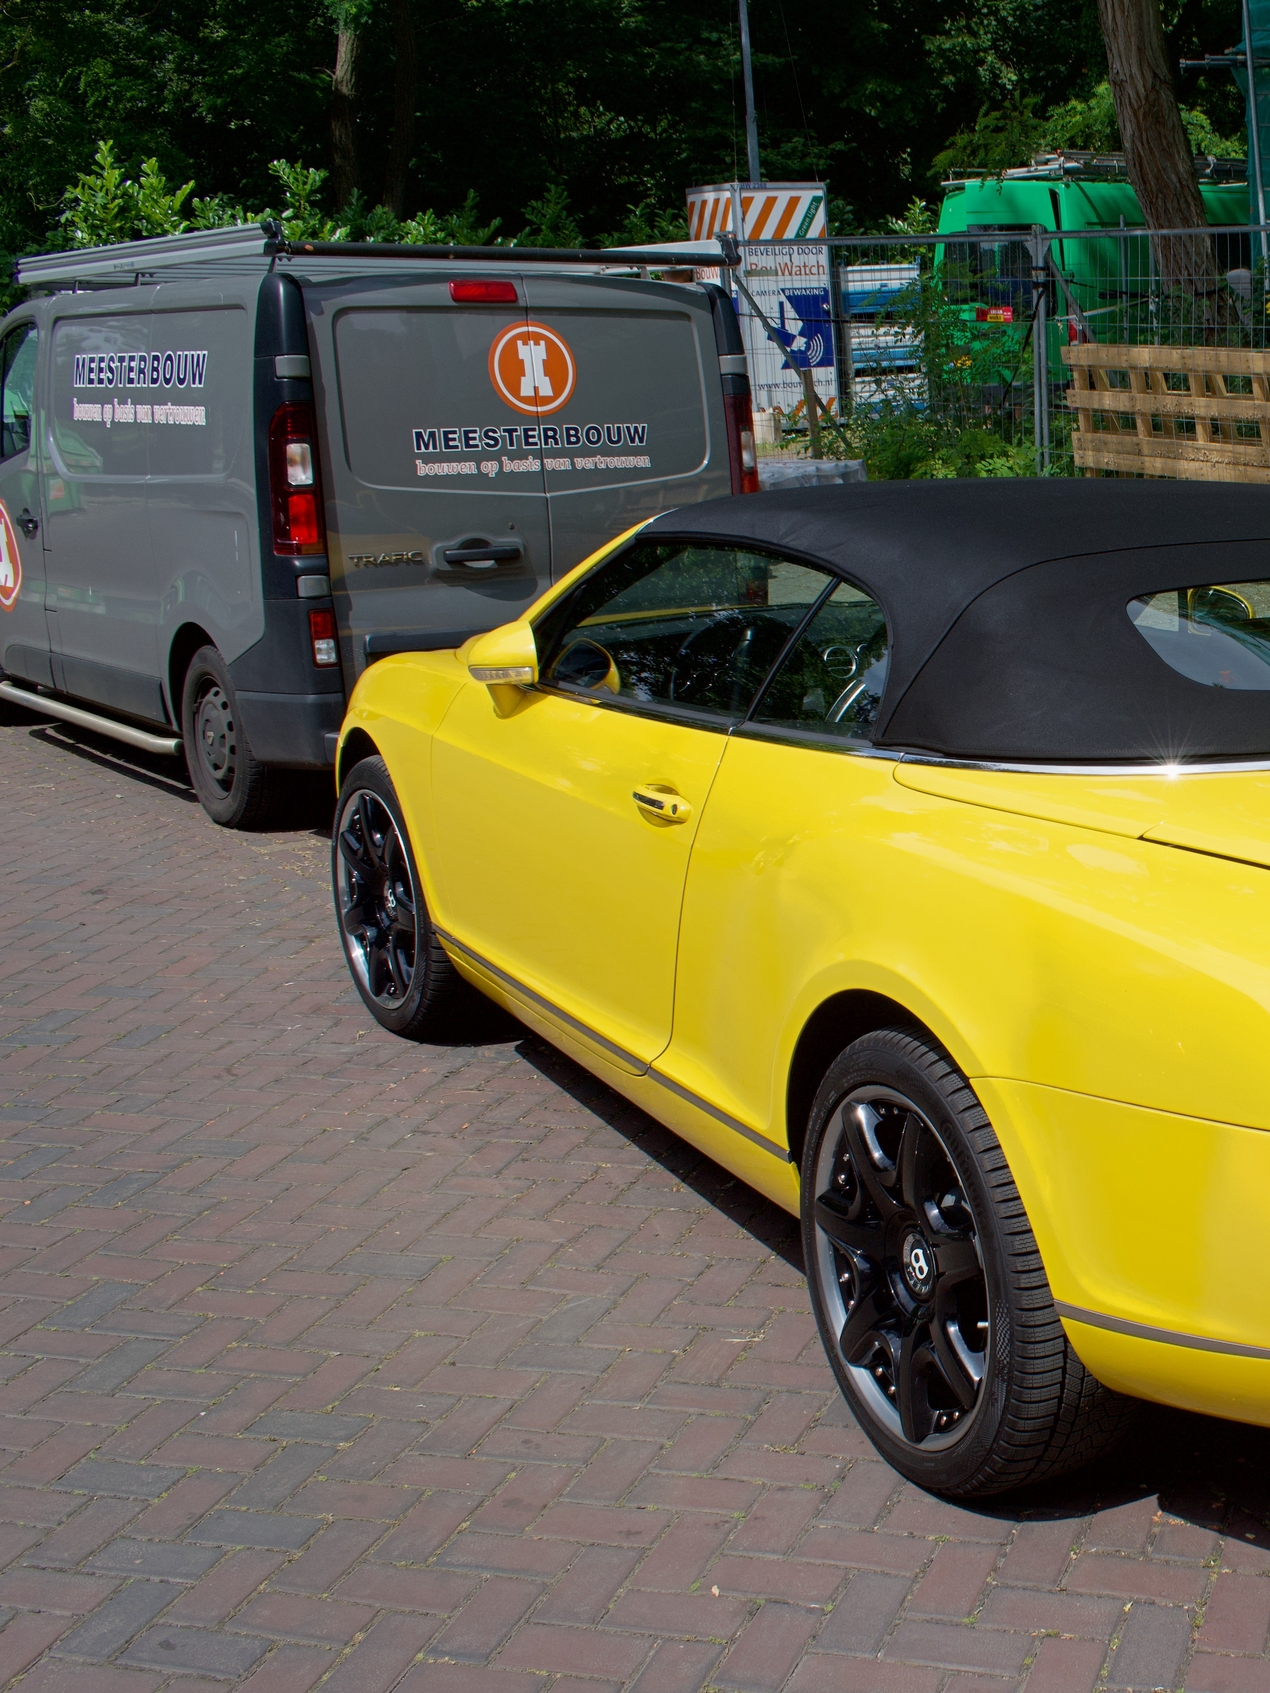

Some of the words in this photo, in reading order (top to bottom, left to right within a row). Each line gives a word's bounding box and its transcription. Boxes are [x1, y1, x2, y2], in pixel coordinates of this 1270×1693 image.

[798, 215, 811, 236] Green
[806, 201, 819, 217] Light
[748, 246, 795, 257] BEVEILIGD
[797, 246, 824, 256] DOOR
[751, 289, 782, 297] CAMERA
[785, 288, 825, 296] BEWAKING
[73, 351, 208, 388] MEESTERBOUW
[73, 398, 102, 421] bouwen
[103, 404, 113, 428] op
[113, 398, 135, 423] basis
[136, 404, 153, 423] van
[153, 402, 207, 426] vertrouwen
[412, 423, 648, 452] MEESTERBOUW
[416, 459, 477, 476] bouwen
[480, 460, 499, 477] op
[502, 456, 541, 472] basis
[544, 457, 571, 470] van
[574, 456, 651, 470] vertrouwen
[347, 550, 423, 567] TRAFIC
